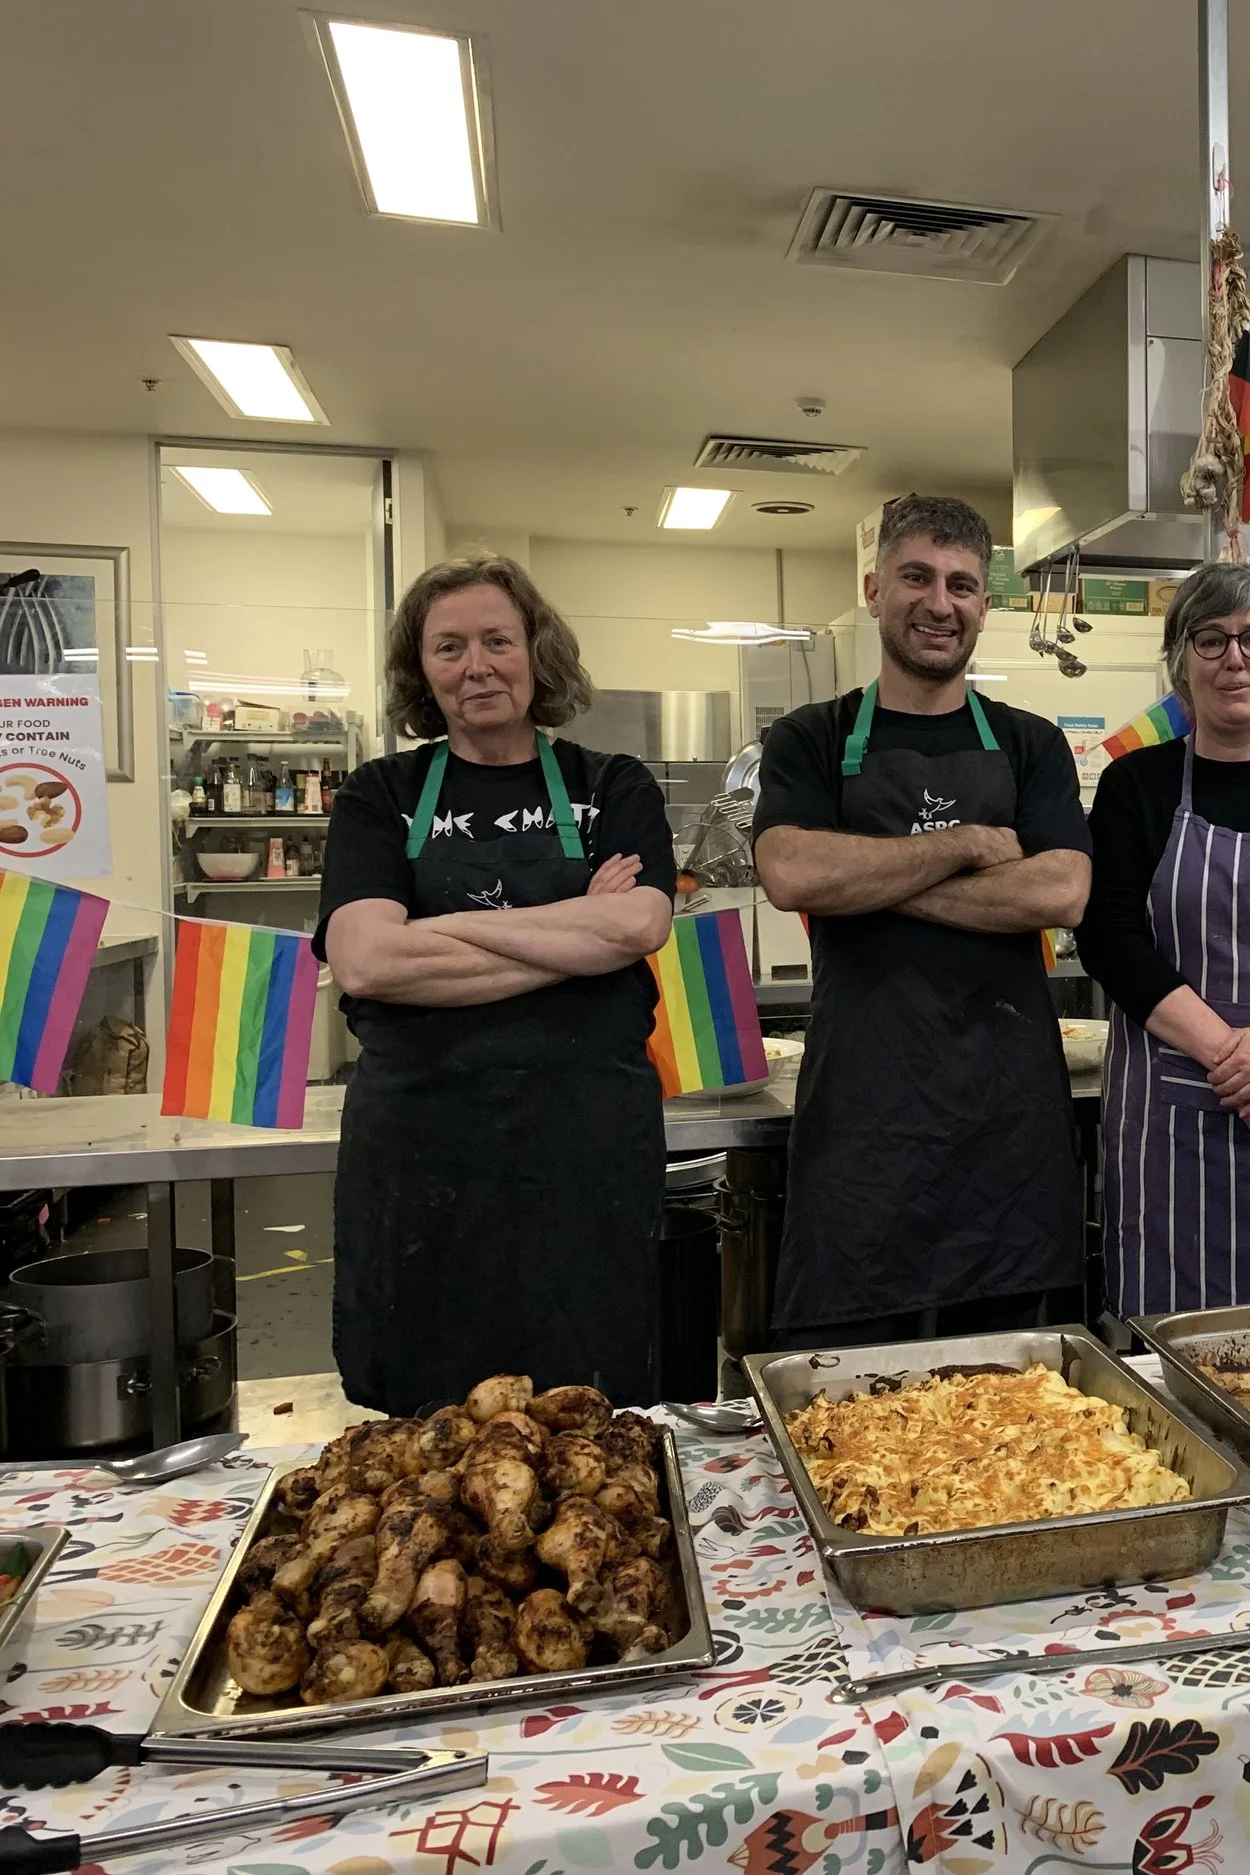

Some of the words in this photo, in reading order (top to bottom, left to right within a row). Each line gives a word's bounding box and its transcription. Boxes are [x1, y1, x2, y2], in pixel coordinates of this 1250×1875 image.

[0, 698, 21, 708] EN
[24, 697, 89, 707] WARNING
[17, 719, 51, 728] FOOD
[5, 731, 70, 741] CONTAIN
[11, 747, 25, 755] or
[28, 746, 56, 758] Tree
[58, 752, 87, 770] Nuts
